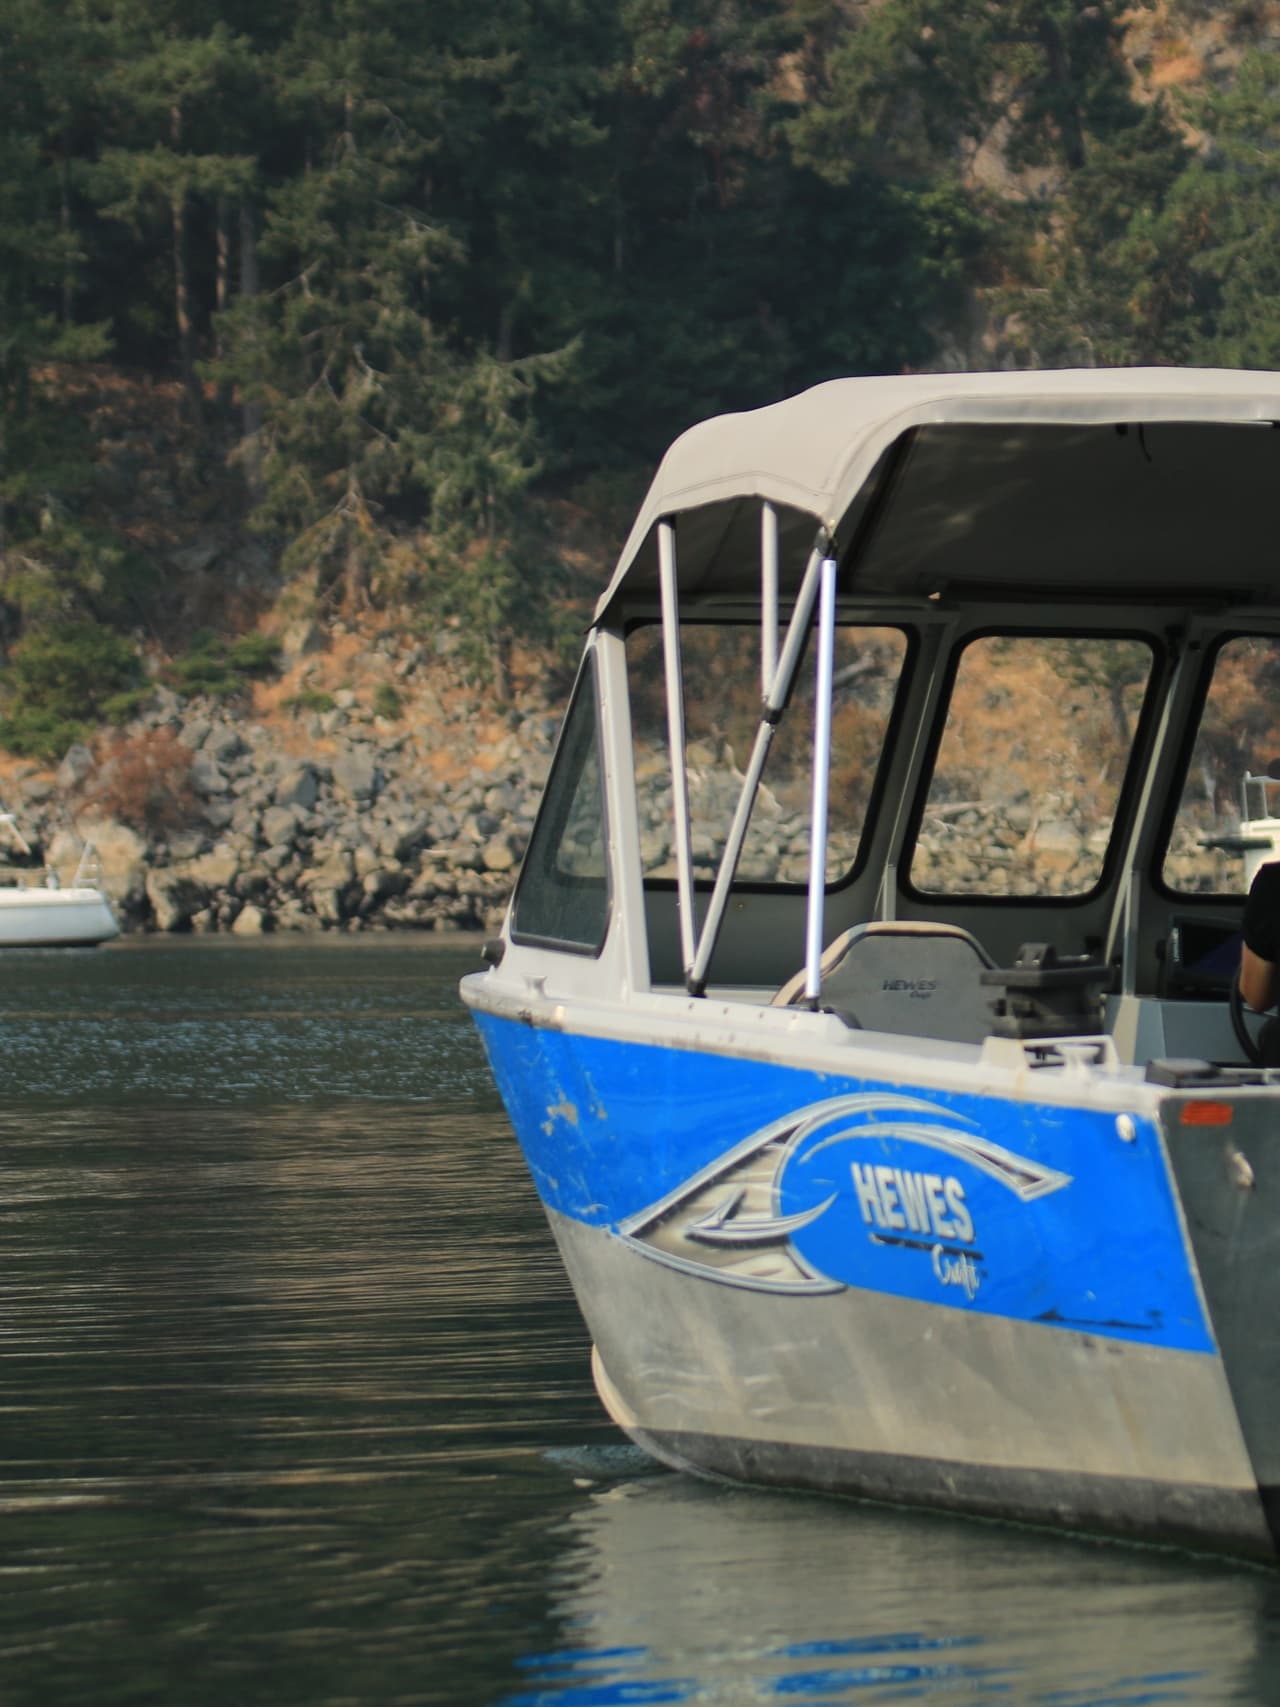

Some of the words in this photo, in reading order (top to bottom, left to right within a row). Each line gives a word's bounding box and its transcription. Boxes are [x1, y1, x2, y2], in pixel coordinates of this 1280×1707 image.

[882, 979, 937, 991] HEWES
[851, 1162, 975, 1243] HEWES
[931, 1243, 980, 1301] Craft
